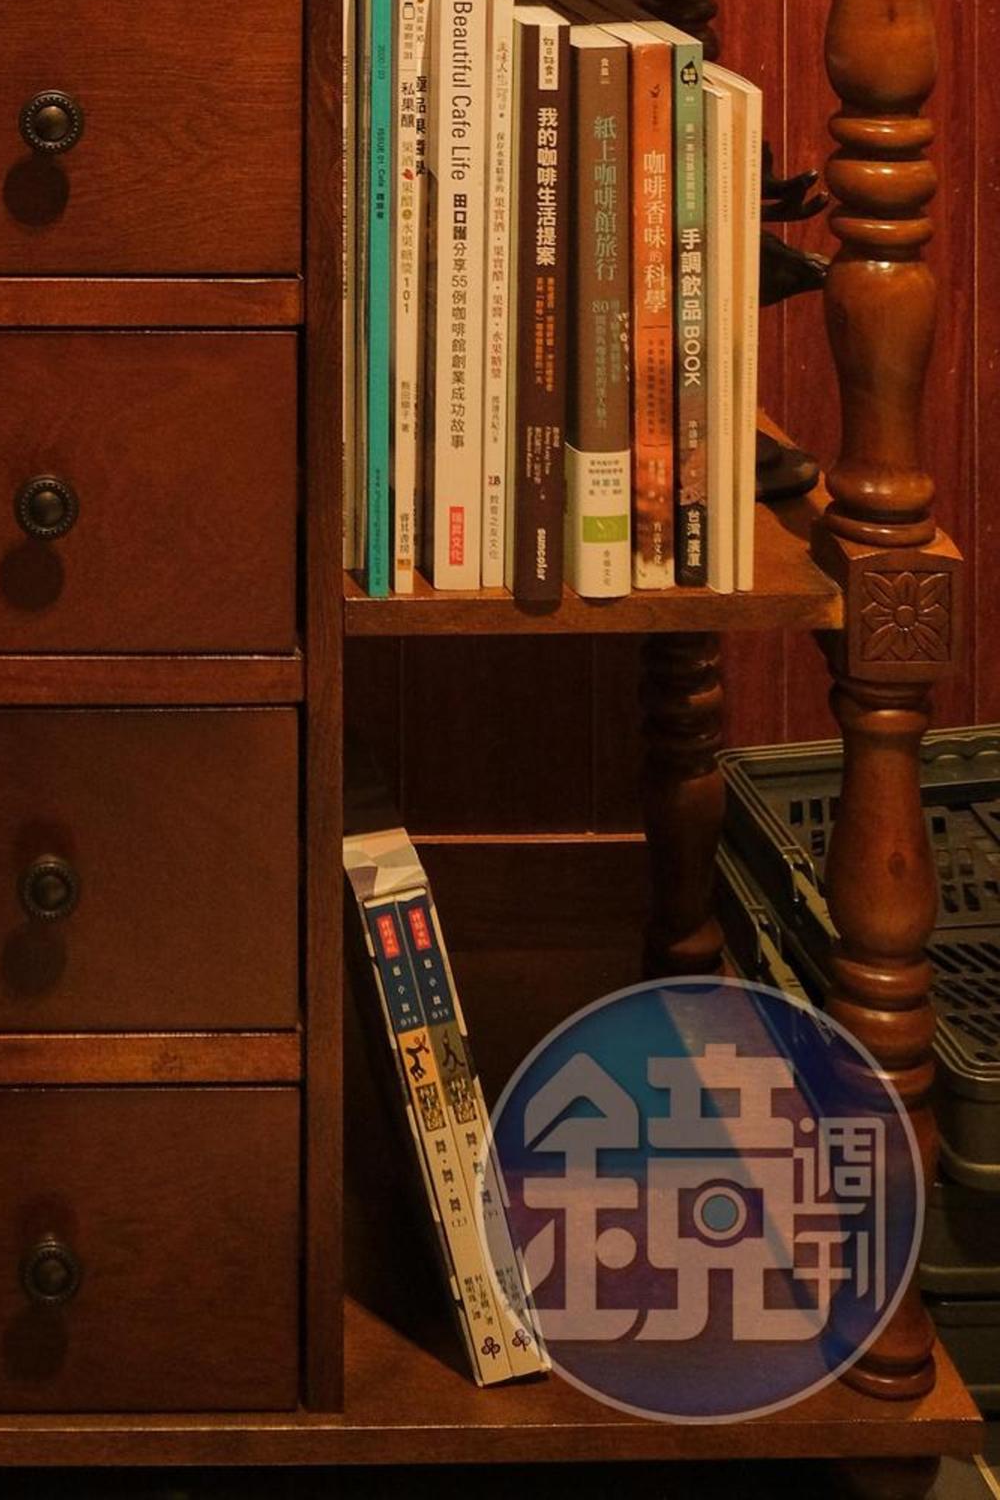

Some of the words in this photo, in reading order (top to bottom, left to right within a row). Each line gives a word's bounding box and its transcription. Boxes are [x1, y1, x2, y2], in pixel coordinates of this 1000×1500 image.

[453, 1, 472, 88] Beautiful
[400, 82, 415, 128] 私果釀
[451, 95, 472, 139] Cafe
[450, 146, 470, 181] Life
[536, 108, 558, 266] 我的咖啡生活提案
[594, 116, 617, 281] 紙上咖啡館旅行
[643, 151, 666, 313] 咖啡香味的科學
[681, 228, 701, 320] 手調飲品
[683, 327, 701, 387] BOOK
[537, 528, 548, 581] suncolor
